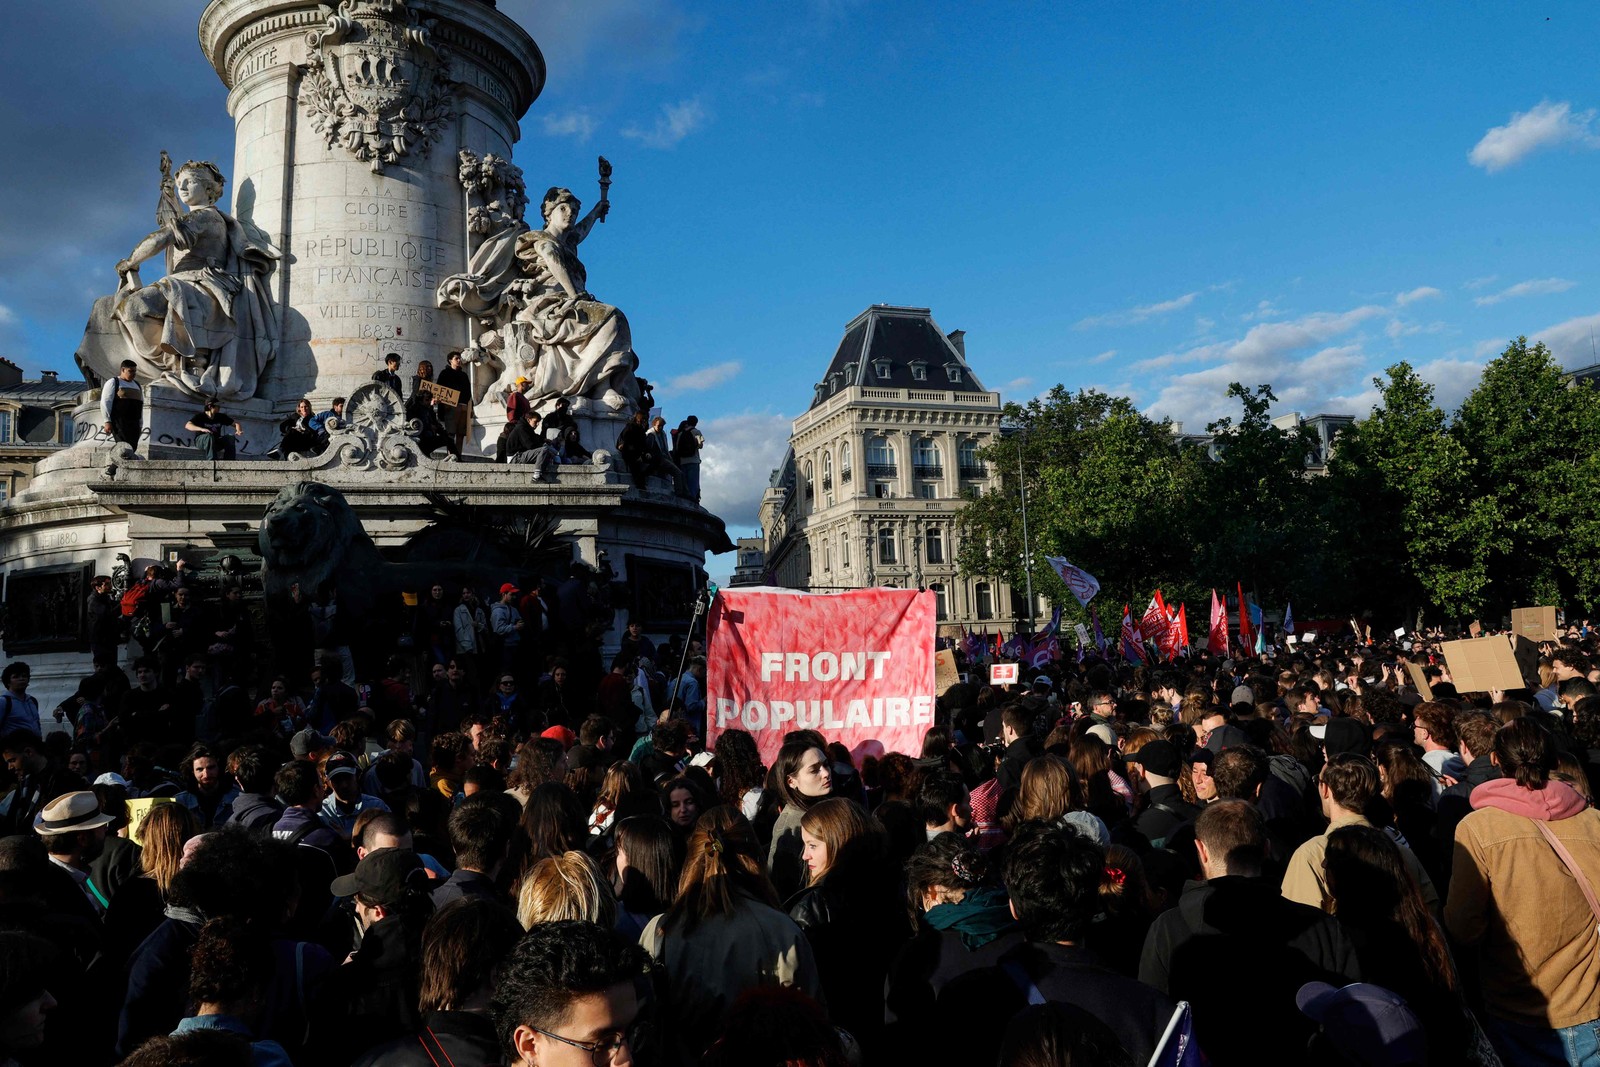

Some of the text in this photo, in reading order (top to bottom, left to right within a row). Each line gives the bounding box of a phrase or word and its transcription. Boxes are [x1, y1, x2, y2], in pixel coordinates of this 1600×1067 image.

[344, 202, 408, 219] GLOIRE
[305, 234, 447, 266] RÉPUBLIQUE
[317, 267, 436, 290] FRANÇAISE
[367, 289, 385, 300] LA
[319, 305, 433, 324] VILLE DE PARIS
[357, 323, 395, 339] 1883
[57, 531, 78, 546] 1880
[761, 651, 892, 682] FRONT
[715, 695, 932, 731] POPULAIRE
